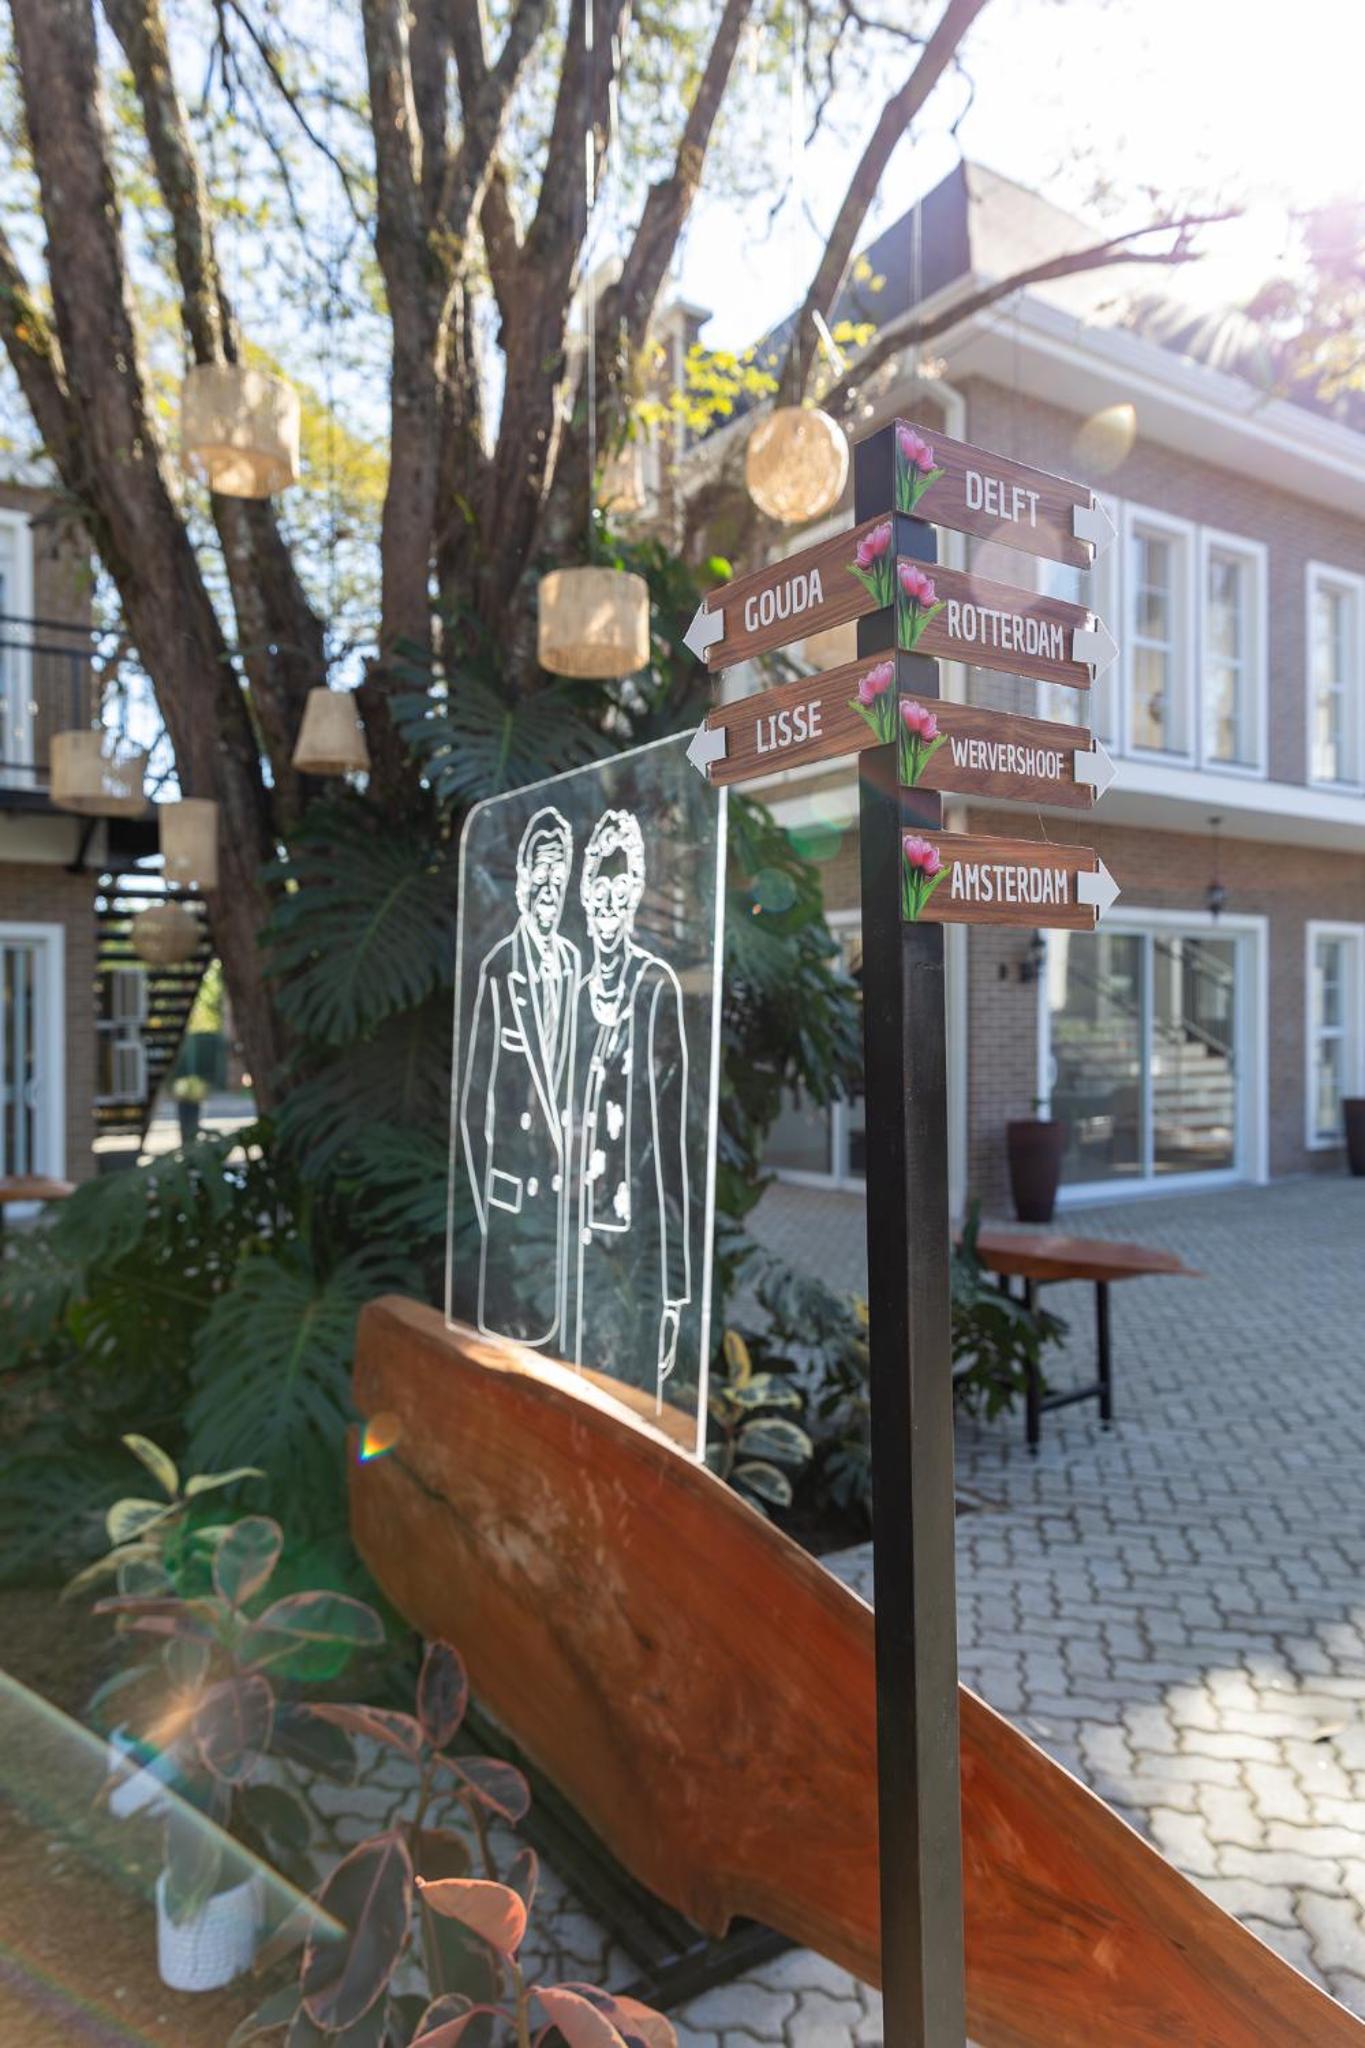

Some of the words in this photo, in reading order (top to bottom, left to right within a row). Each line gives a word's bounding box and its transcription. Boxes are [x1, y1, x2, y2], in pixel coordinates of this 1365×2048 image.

[965, 470, 1041, 528] DELFT
[744, 568, 824, 633] GOUDA
[947, 599, 1064, 661] ROTTERDAM
[756, 700, 823, 754] LISSE
[951, 736, 1065, 781] WERVERSHOOF
[951, 861, 1068, 905] AMSTERDAM
